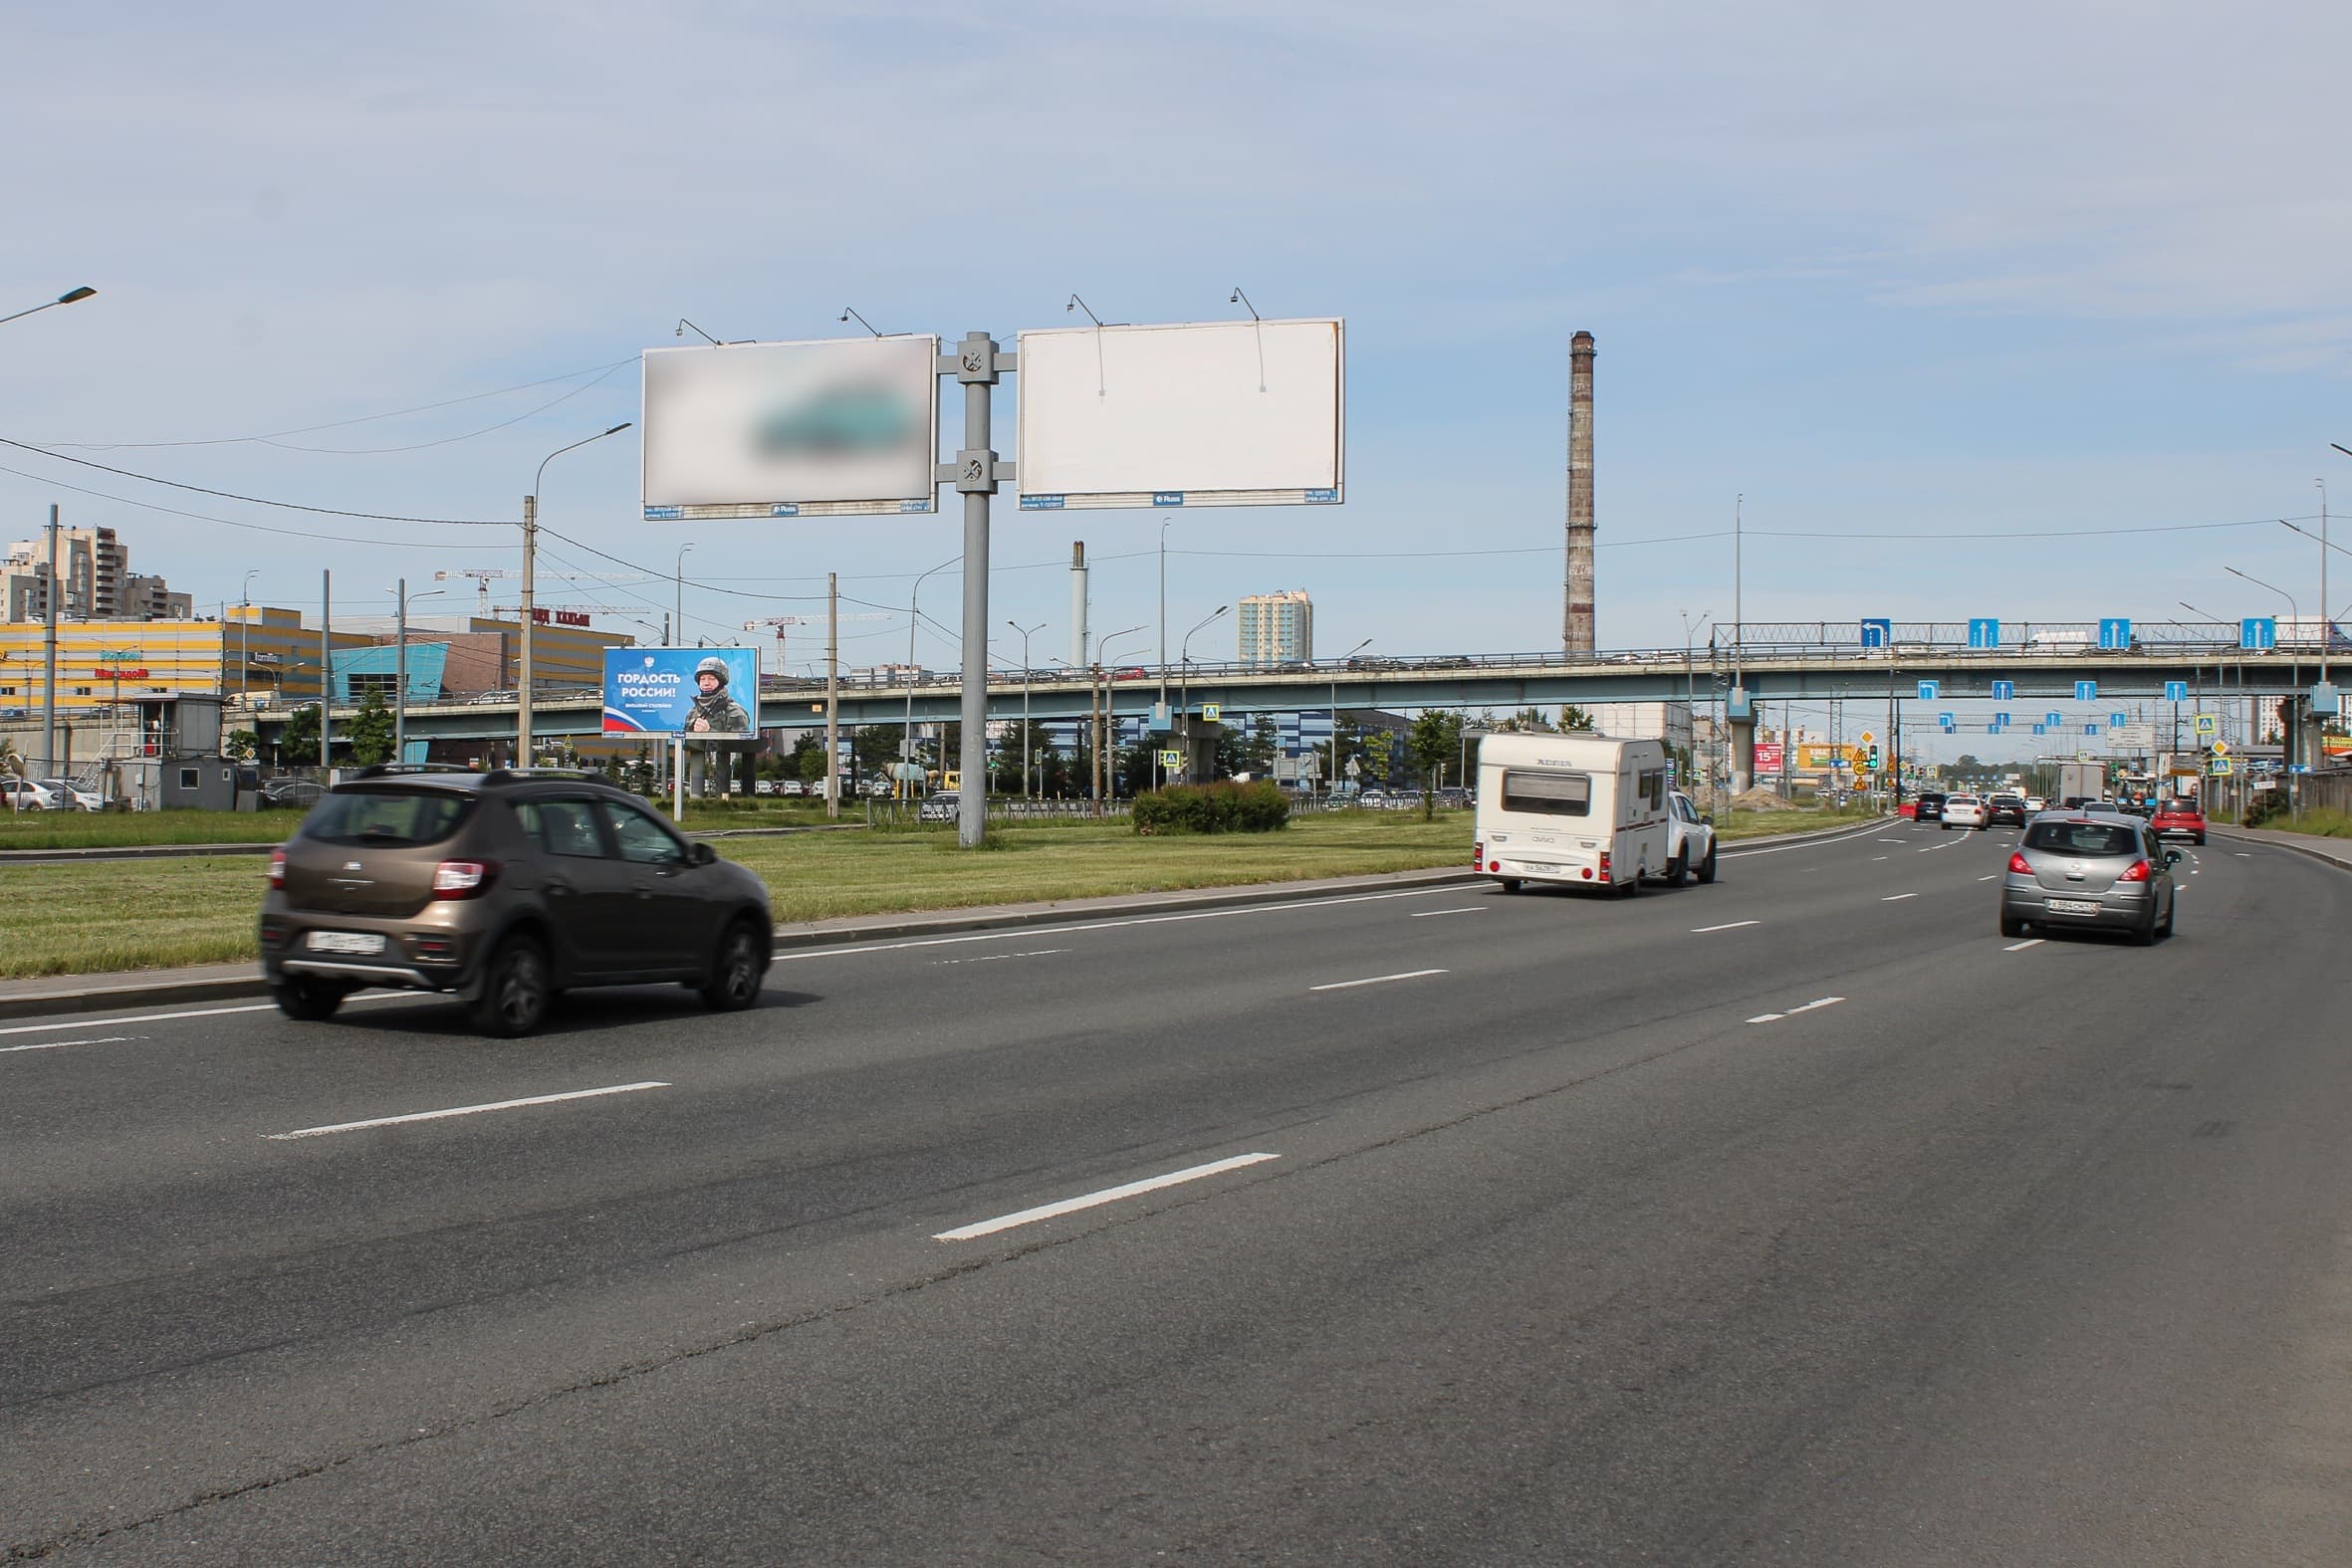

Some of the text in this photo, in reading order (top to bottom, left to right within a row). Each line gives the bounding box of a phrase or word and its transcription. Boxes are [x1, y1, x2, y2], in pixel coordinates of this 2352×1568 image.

[617, 673, 681, 685] ГОРДОСТЬ
[621, 687, 676, 698] РОССИИ!
[1757, 752, 1771, 762] 15
